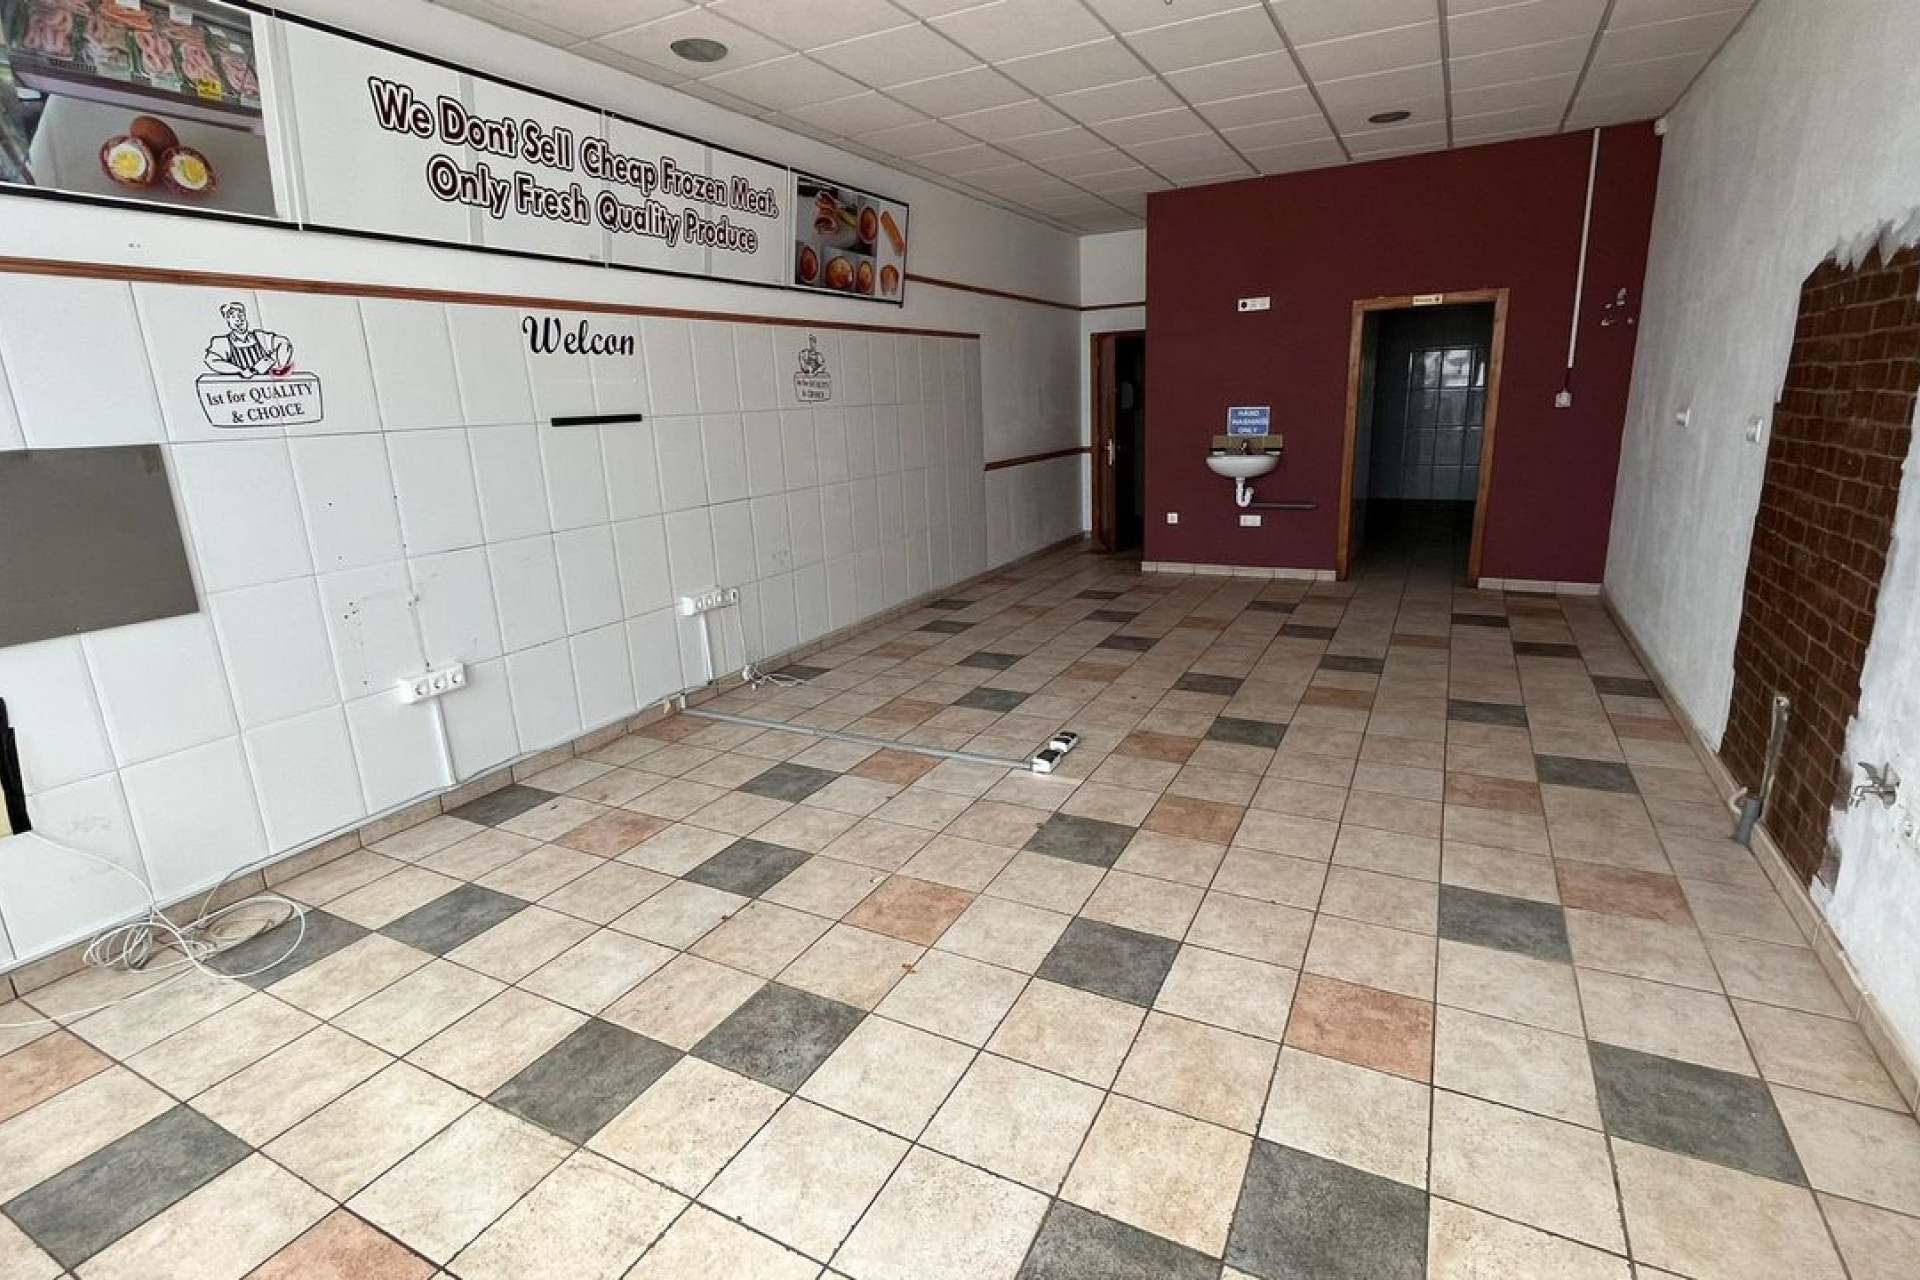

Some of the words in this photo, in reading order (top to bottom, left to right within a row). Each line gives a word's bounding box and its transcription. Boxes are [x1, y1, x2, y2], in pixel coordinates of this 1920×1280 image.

[368, 77, 433, 137] We
[437, 95, 517, 158] Dont
[521, 120, 573, 170] Sell
[580, 137, 657, 196] Cheap
[660, 156, 727, 206] Frozen
[427, 154, 510, 219] Only
[514, 171, 590, 226] Fresh
[597, 191, 680, 247] Quality
[683, 208, 758, 254] Produce
[226, 390, 246, 403] for
[249, 383, 312, 404] QUALITY
[231, 410, 244, 423] &
[247, 403, 305, 421] CHOICE
